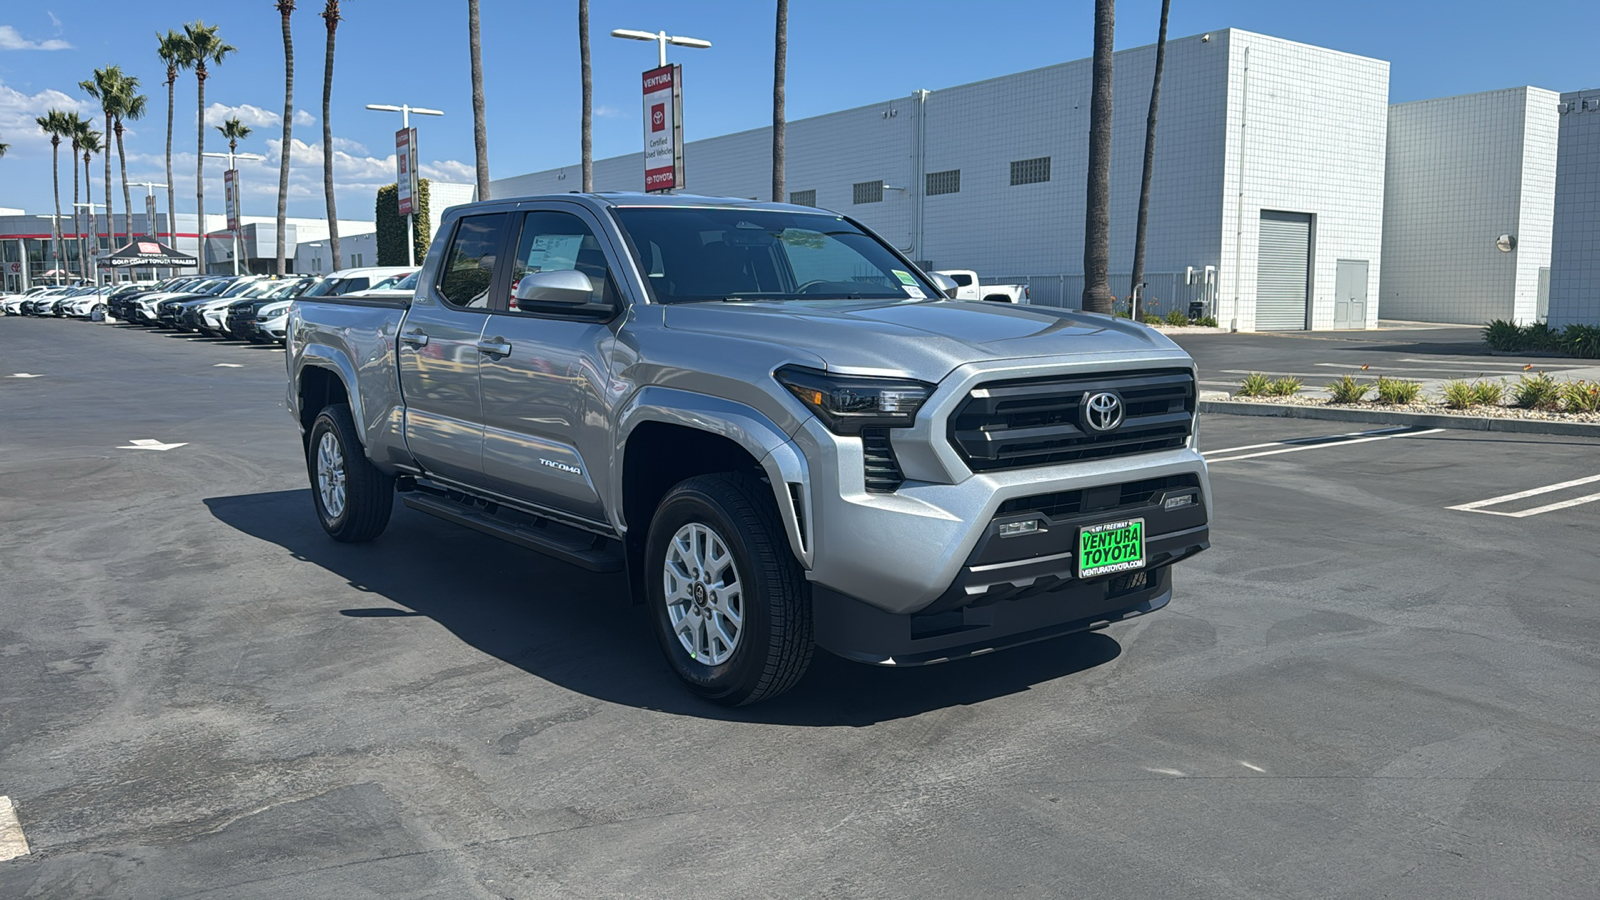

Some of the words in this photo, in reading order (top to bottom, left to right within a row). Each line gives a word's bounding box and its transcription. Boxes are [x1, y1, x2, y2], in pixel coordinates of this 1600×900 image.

[644, 72, 672, 88] VENTURA
[650, 137, 668, 148] Certified
[652, 172, 673, 183] TOYOTA
[539, 457, 581, 475] TACOMA
[1103, 521, 1128, 531] FREEWAY
[1082, 527, 1139, 551] VENTURA
[1084, 542, 1138, 566] TOYOTA
[1082, 560, 1143, 577] VENTURATOYOTA.COM
